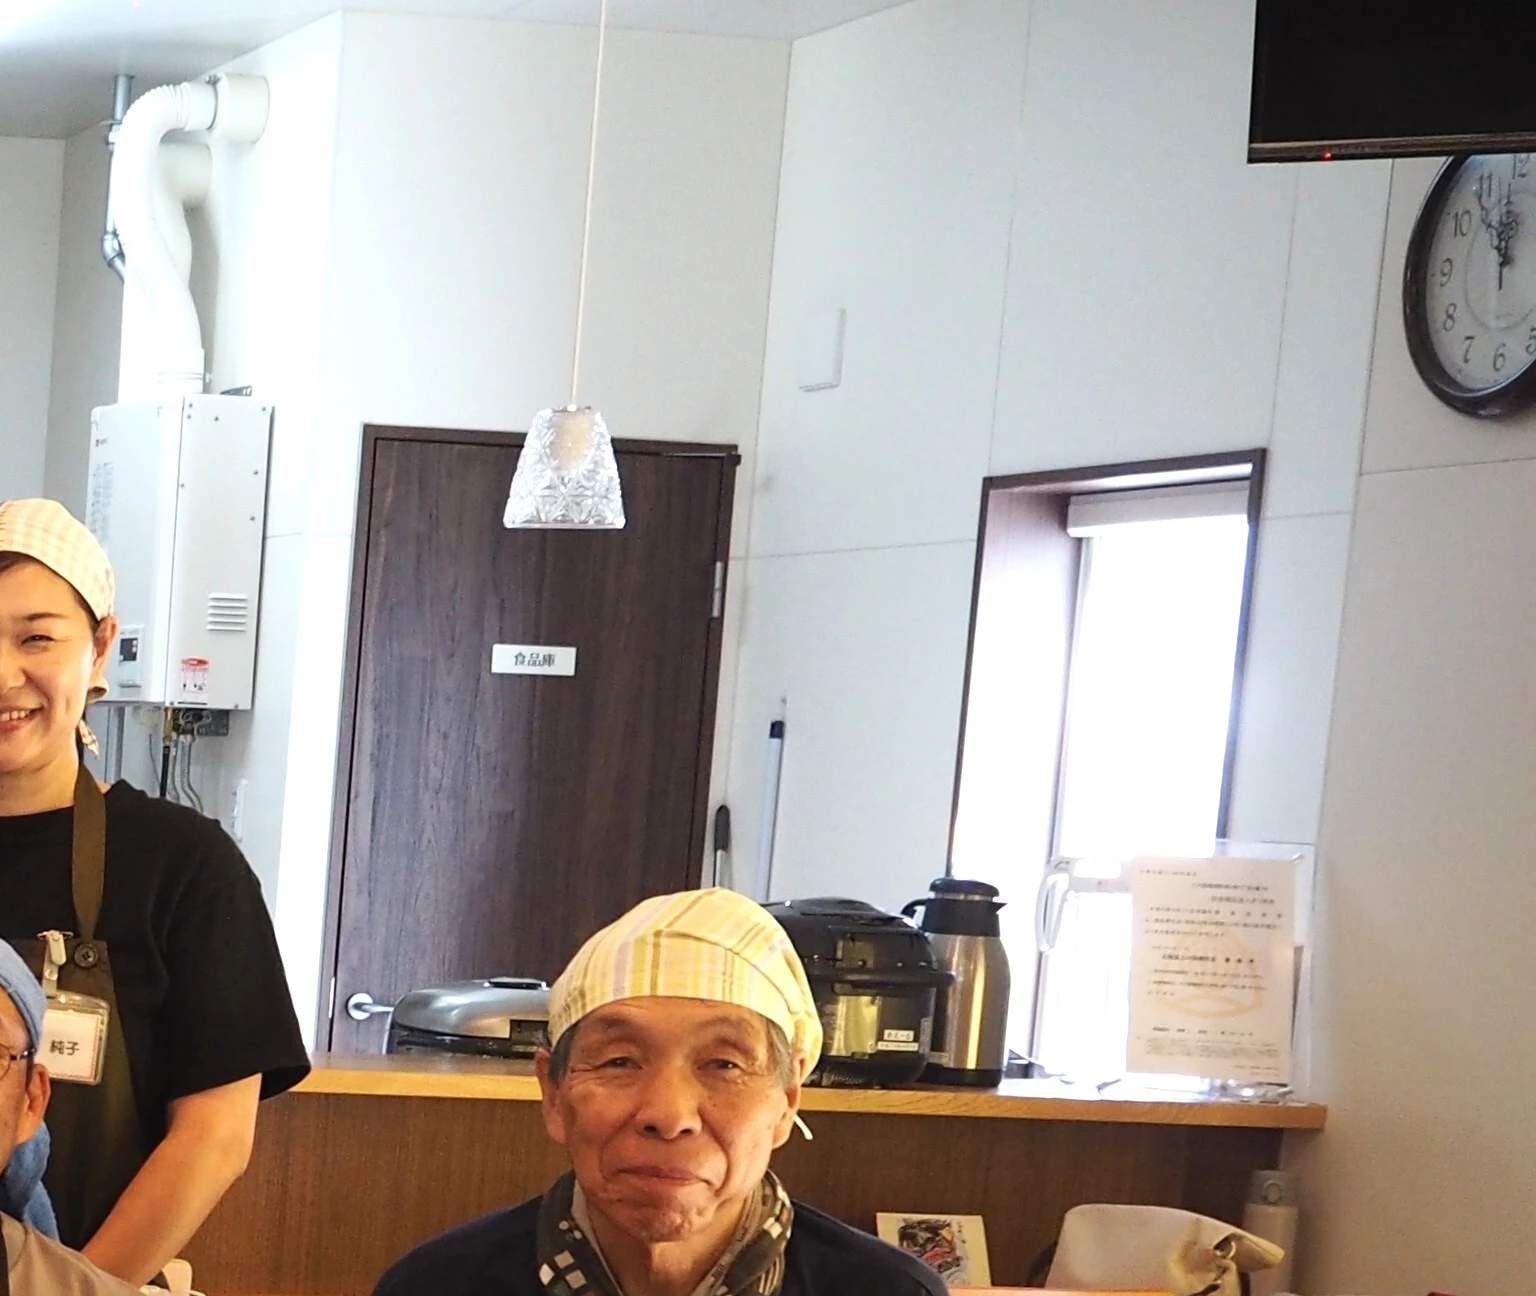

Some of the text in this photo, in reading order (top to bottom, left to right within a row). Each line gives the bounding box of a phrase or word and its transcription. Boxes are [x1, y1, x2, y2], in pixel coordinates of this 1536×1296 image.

[1452, 209, 1473, 238] 10
[1439, 257, 1453, 287] 9
[1443, 302, 1457, 332] 8
[1463, 335, 1475, 364] 7
[1493, 342, 1506, 372] 6
[514, 652, 556, 668] 食品庫
